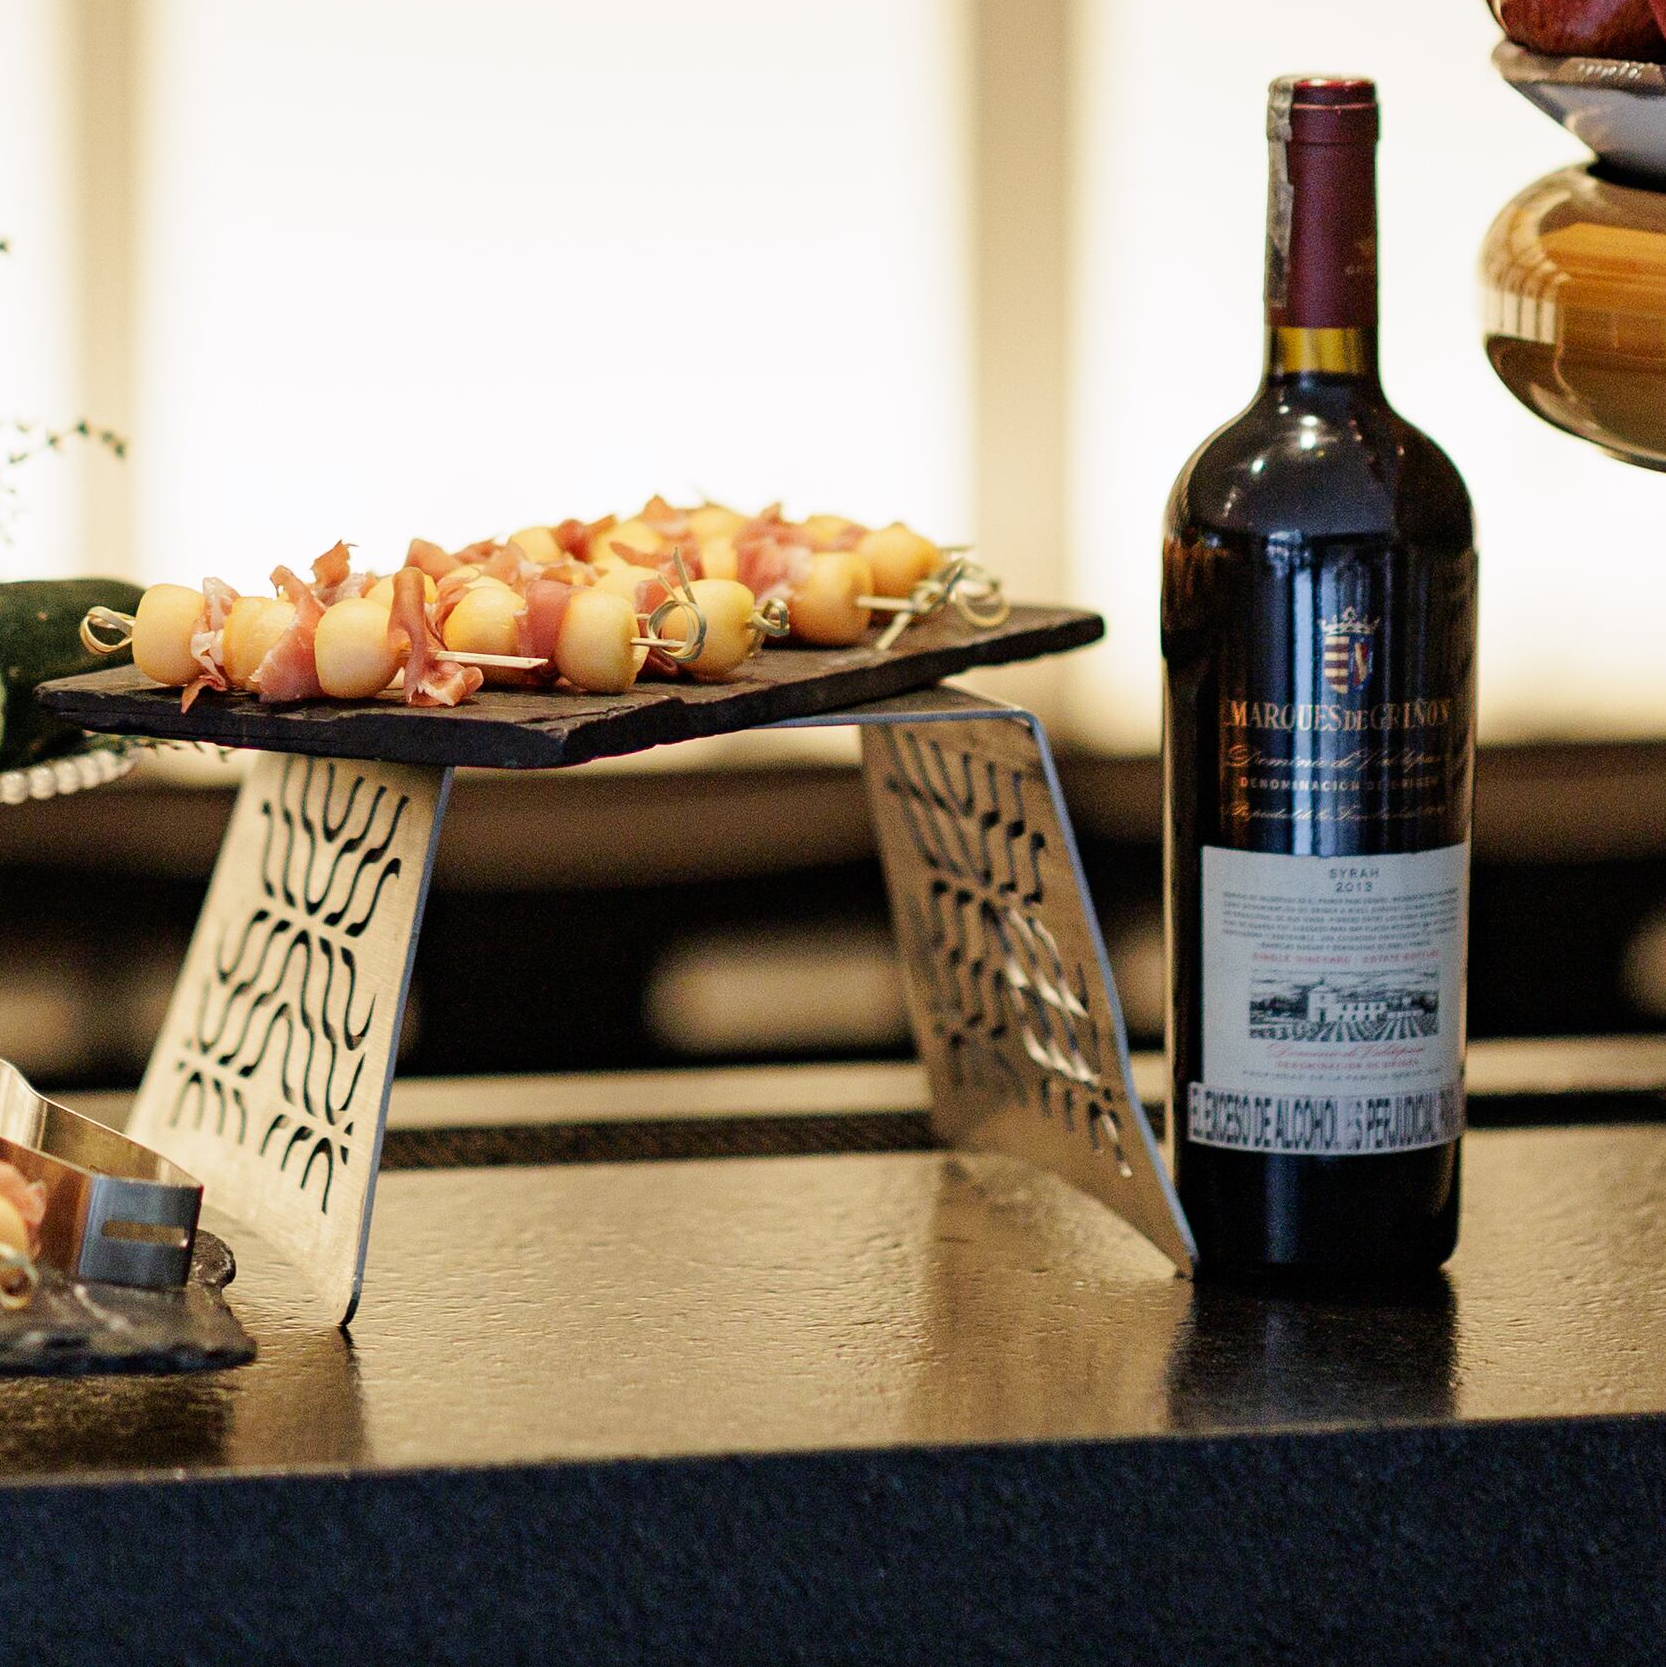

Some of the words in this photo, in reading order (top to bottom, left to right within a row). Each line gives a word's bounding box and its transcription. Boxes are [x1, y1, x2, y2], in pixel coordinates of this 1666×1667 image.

[1227, 700, 1341, 733] MARQUES
[1343, 709, 1367, 731] DE
[1329, 867, 1379, 879] SYRAH
